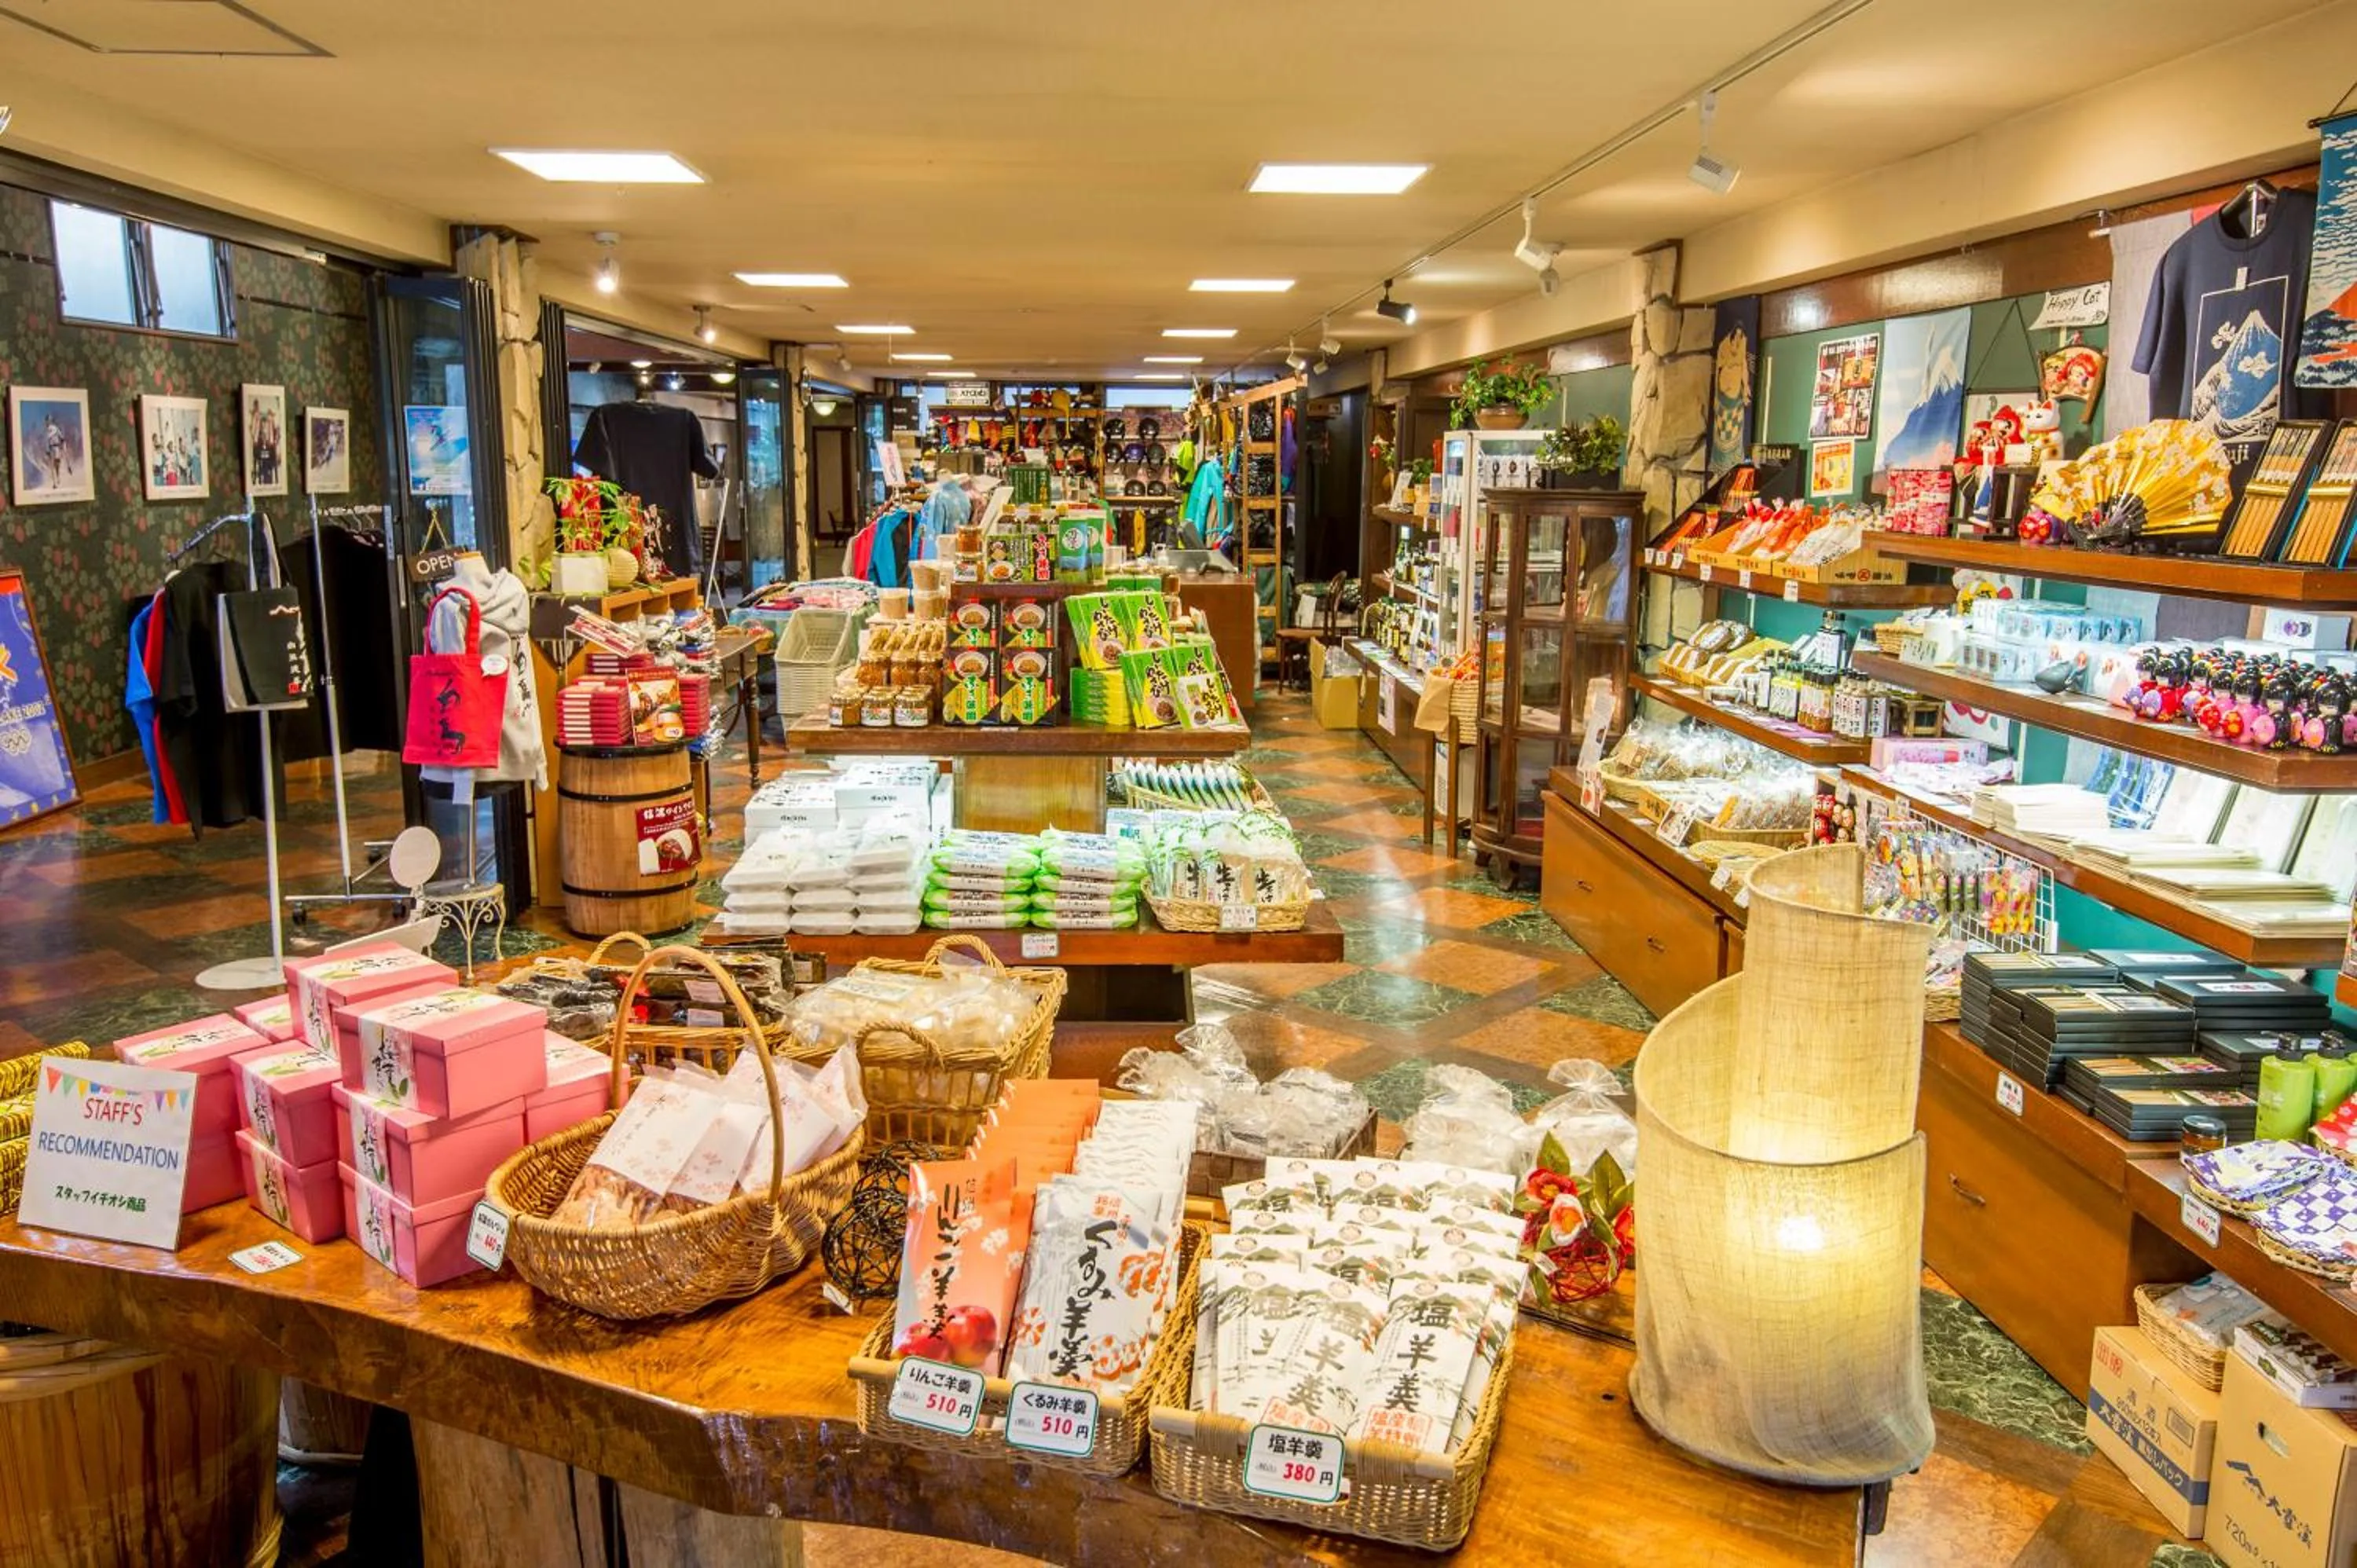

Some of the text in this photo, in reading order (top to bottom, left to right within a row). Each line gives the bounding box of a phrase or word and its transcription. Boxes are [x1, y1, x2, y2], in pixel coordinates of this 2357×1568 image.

[2083, 288, 2101, 306] Cat
[83, 1097, 144, 1126] STAFF'S
[38, 1130, 179, 1170] RECOMMENDATION
[55, 1185, 146, 1212] スタッフイチオシ商品
[909, 1366, 973, 1394] りんご羊羹
[926, 1393, 957, 1415] 510
[959, 1403, 973, 1419] 円
[1023, 1392, 1087, 1415] くるみ羊羹
[1042, 1415, 1073, 1435] 510
[1076, 1425, 1090, 1439] 円
[1267, 1433, 1324, 1460] 塩羊羹
[1282, 1462, 1316, 1483] 380
[1319, 1471, 1334, 1486] 円
